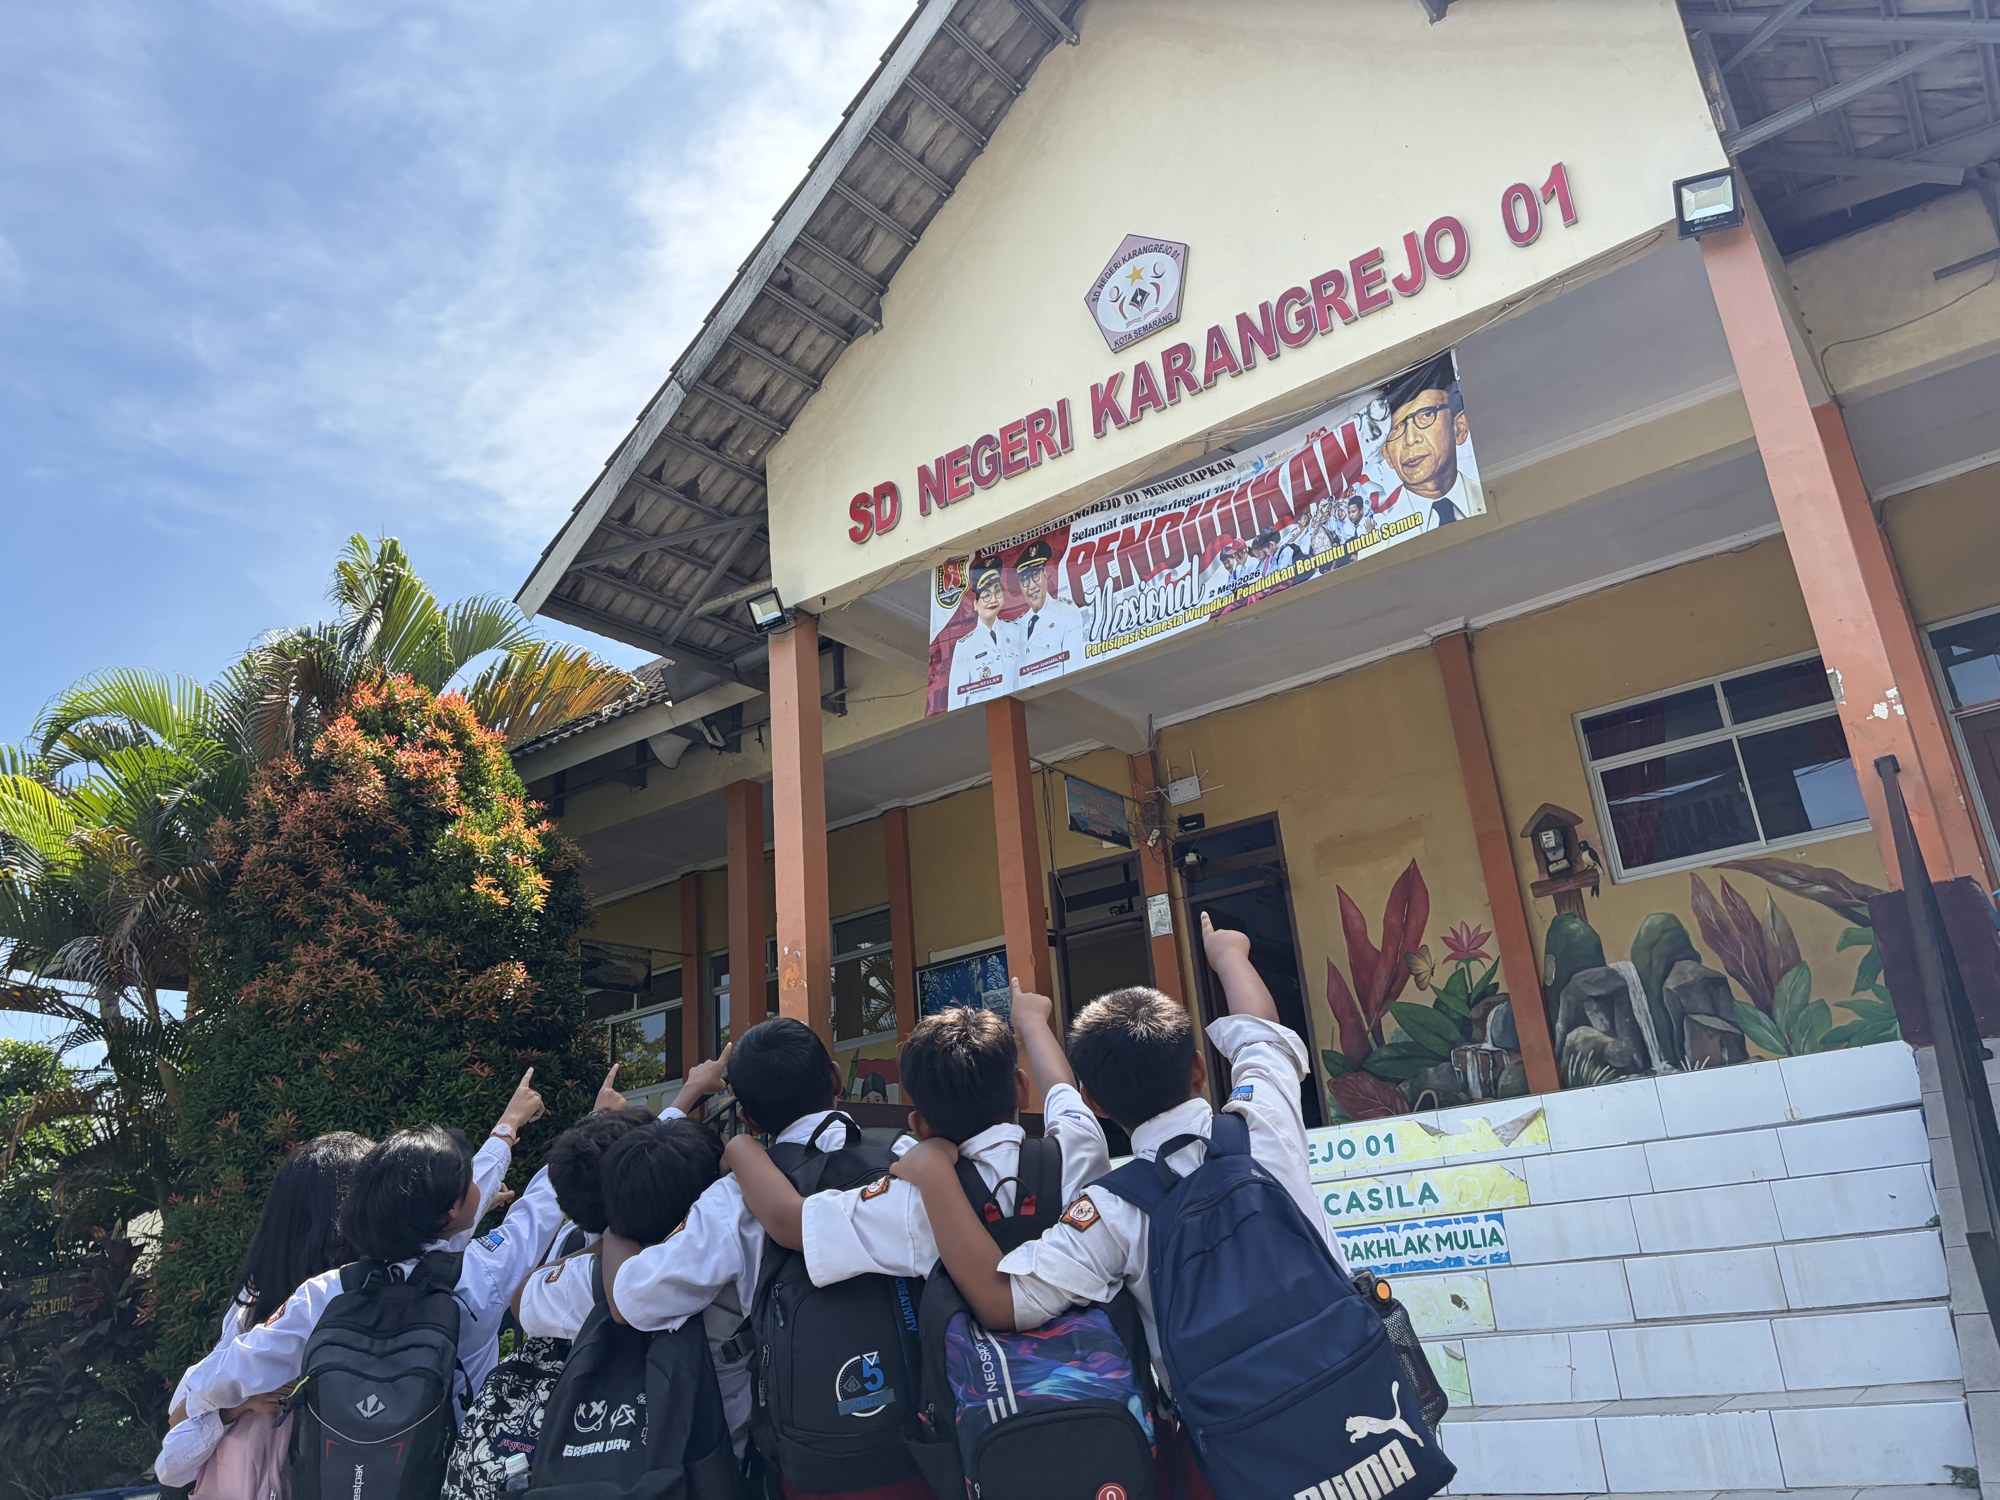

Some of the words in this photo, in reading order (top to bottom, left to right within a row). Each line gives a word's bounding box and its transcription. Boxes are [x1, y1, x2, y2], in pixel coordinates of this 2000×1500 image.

[1091, 291, 1101, 303] SD
[1097, 261, 1122, 290] NEGERI
[1121, 243, 1173, 264] KARANGREJO
[1170, 251, 1181, 261] 01
[1114, 332, 1133, 348] KOTA
[1133, 312, 1174, 338] SEMARANG
[848, 481, 901, 545] SD
[917, 397, 1075, 517] NEGERI
[1090, 215, 1471, 439] KARANGREJO
[1500, 162, 1578, 247] 01
[1123, 493, 1141, 507] 01
[1141, 458, 1236, 501] MENGUCAPKAN
[1065, 421, 1369, 607] PENDIDIKAN
[1071, 518, 1119, 543] Selamat
[1120, 488, 1212, 526] Memperingati
[1213, 477, 1242, 496] Hari
[1084, 554, 1205, 642] Nasional
[1085, 630, 1139, 659] Partisipasi
[1140, 616, 1183, 640] Semesta
[1184, 594, 1235, 623] Wujudkan
[1236, 565, 1296, 601] Pendidikan
[1296, 544, 1345, 576] Bermutu
[1346, 529, 1382, 554] untuk
[1381, 512, 1423, 542] Semua
[1208, 588, 1215, 599] 2
[1237, 569, 1261, 586] 2026
[1365, 1132, 1396, 1157] 01
[1323, 1181, 1439, 1216] CASILA
[1434, 1226, 1504, 1253] MULIA
[862, 1355, 885, 1392] 5
[562, 1440, 605, 1458] GREEN
[604, 1438, 631, 1453] DAY
